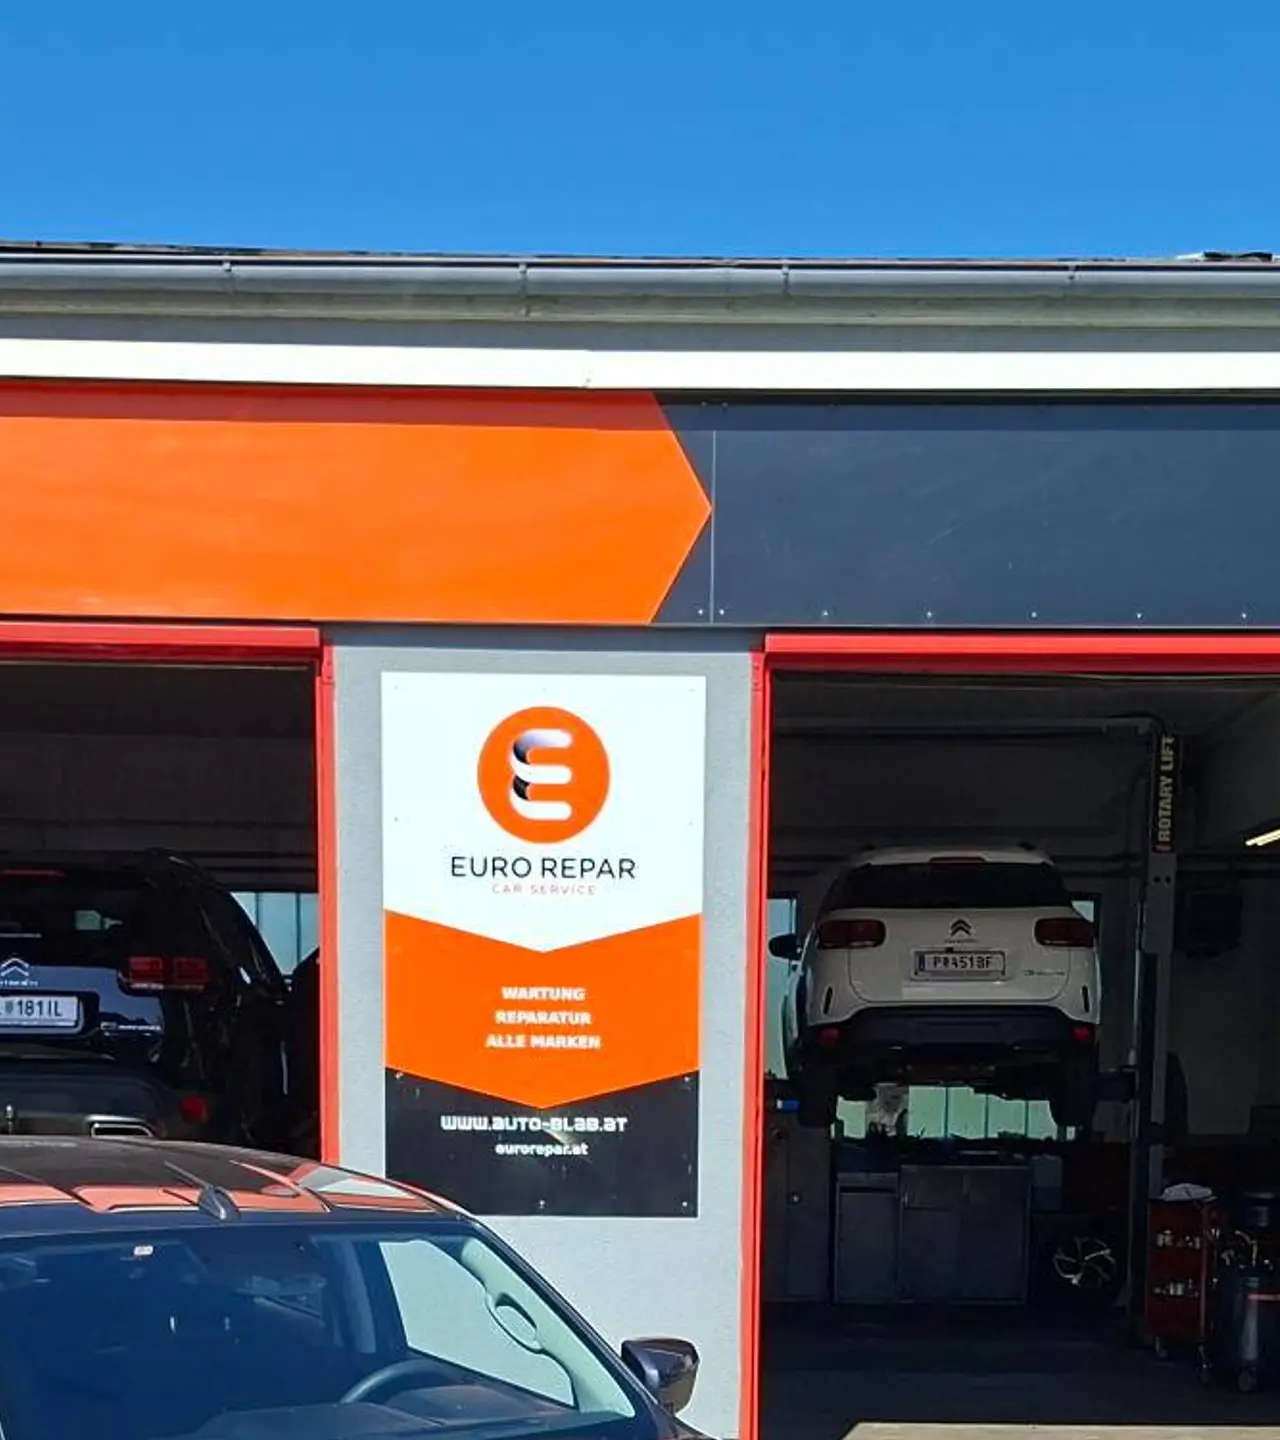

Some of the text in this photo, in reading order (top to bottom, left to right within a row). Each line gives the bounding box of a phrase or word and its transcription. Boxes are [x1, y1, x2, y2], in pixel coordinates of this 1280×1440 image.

[1158, 734, 1175, 842] ROTARY LIFT
[451, 856, 637, 880] EURO REPAR
[502, 987, 586, 1002] WARTUNG
[495, 1010, 591, 1025] REPARATUR
[485, 1034, 600, 1049] ALLE MARKEN
